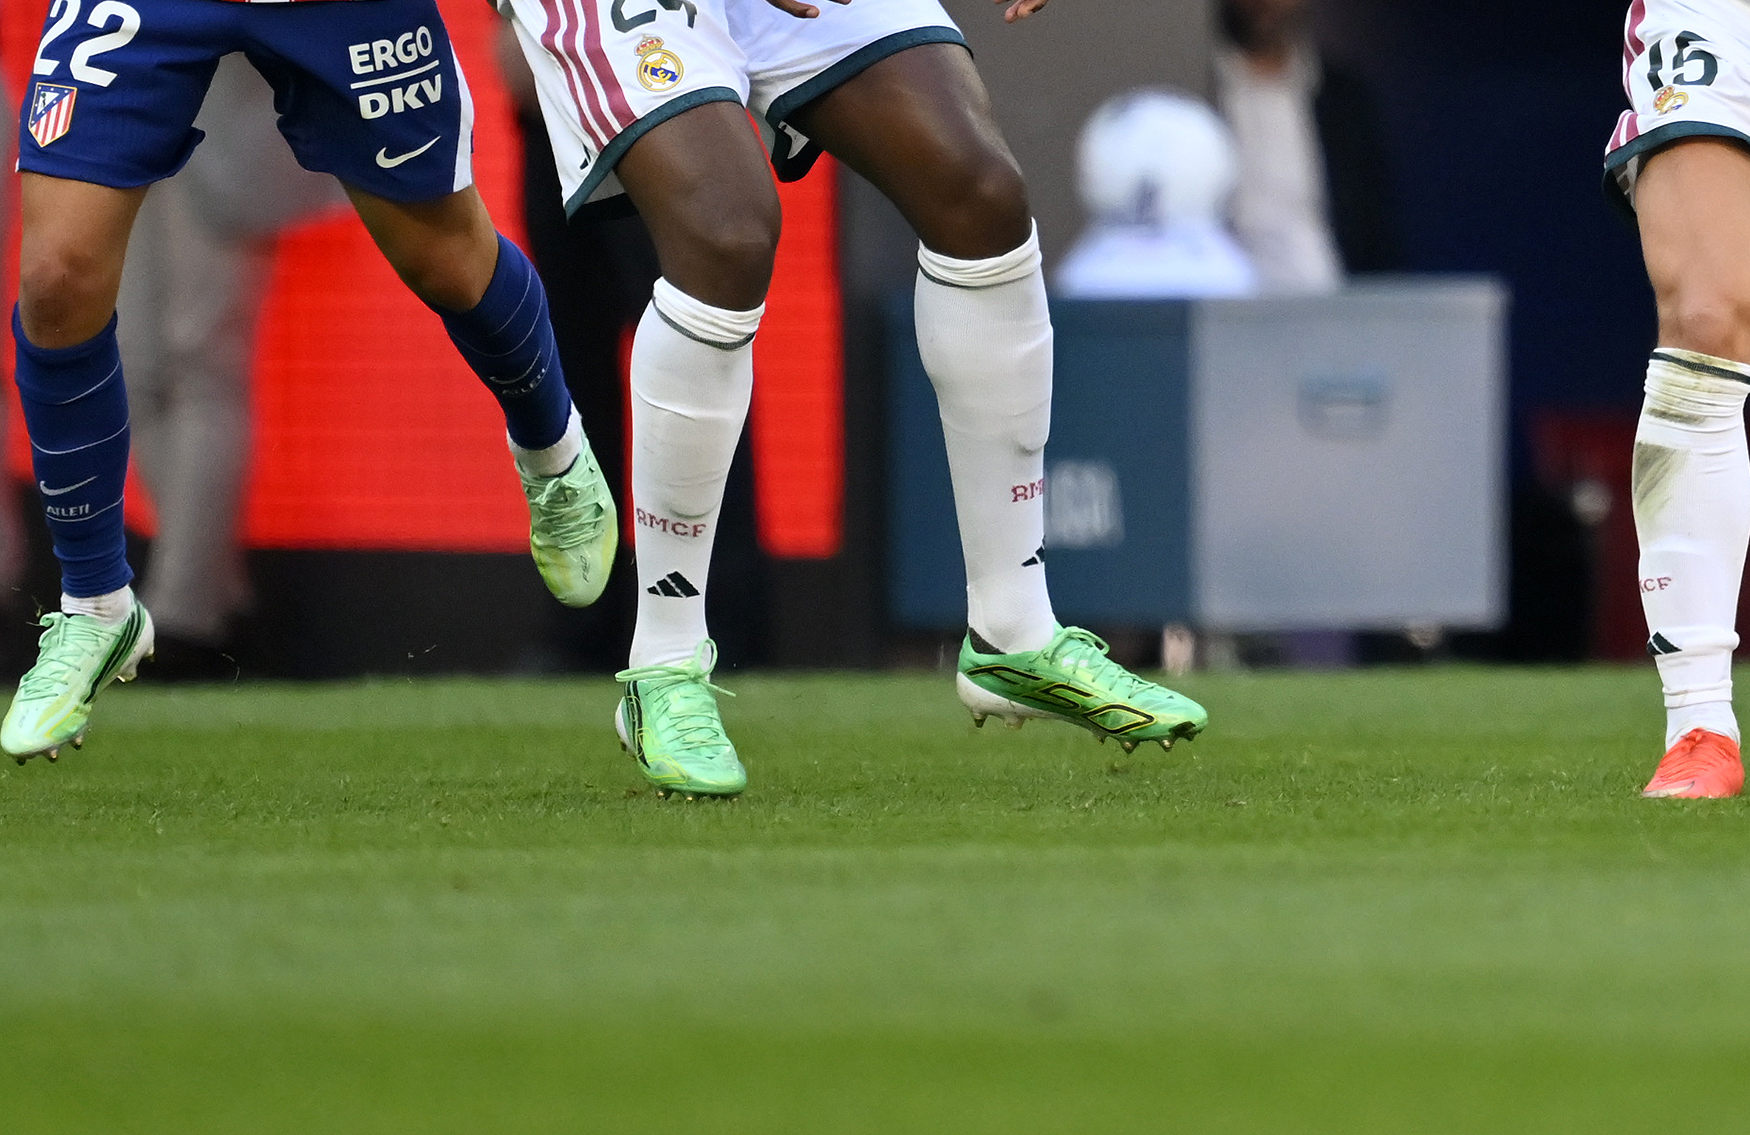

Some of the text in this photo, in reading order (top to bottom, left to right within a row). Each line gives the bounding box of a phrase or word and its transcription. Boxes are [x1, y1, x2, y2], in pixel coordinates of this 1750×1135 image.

[348, 25, 433, 75] ERGO
[1647, 30, 1718, 92] 15
[359, 74, 442, 120] DKV
[46, 503, 90, 517] ATLETI
[636, 507, 707, 537] RMCF
